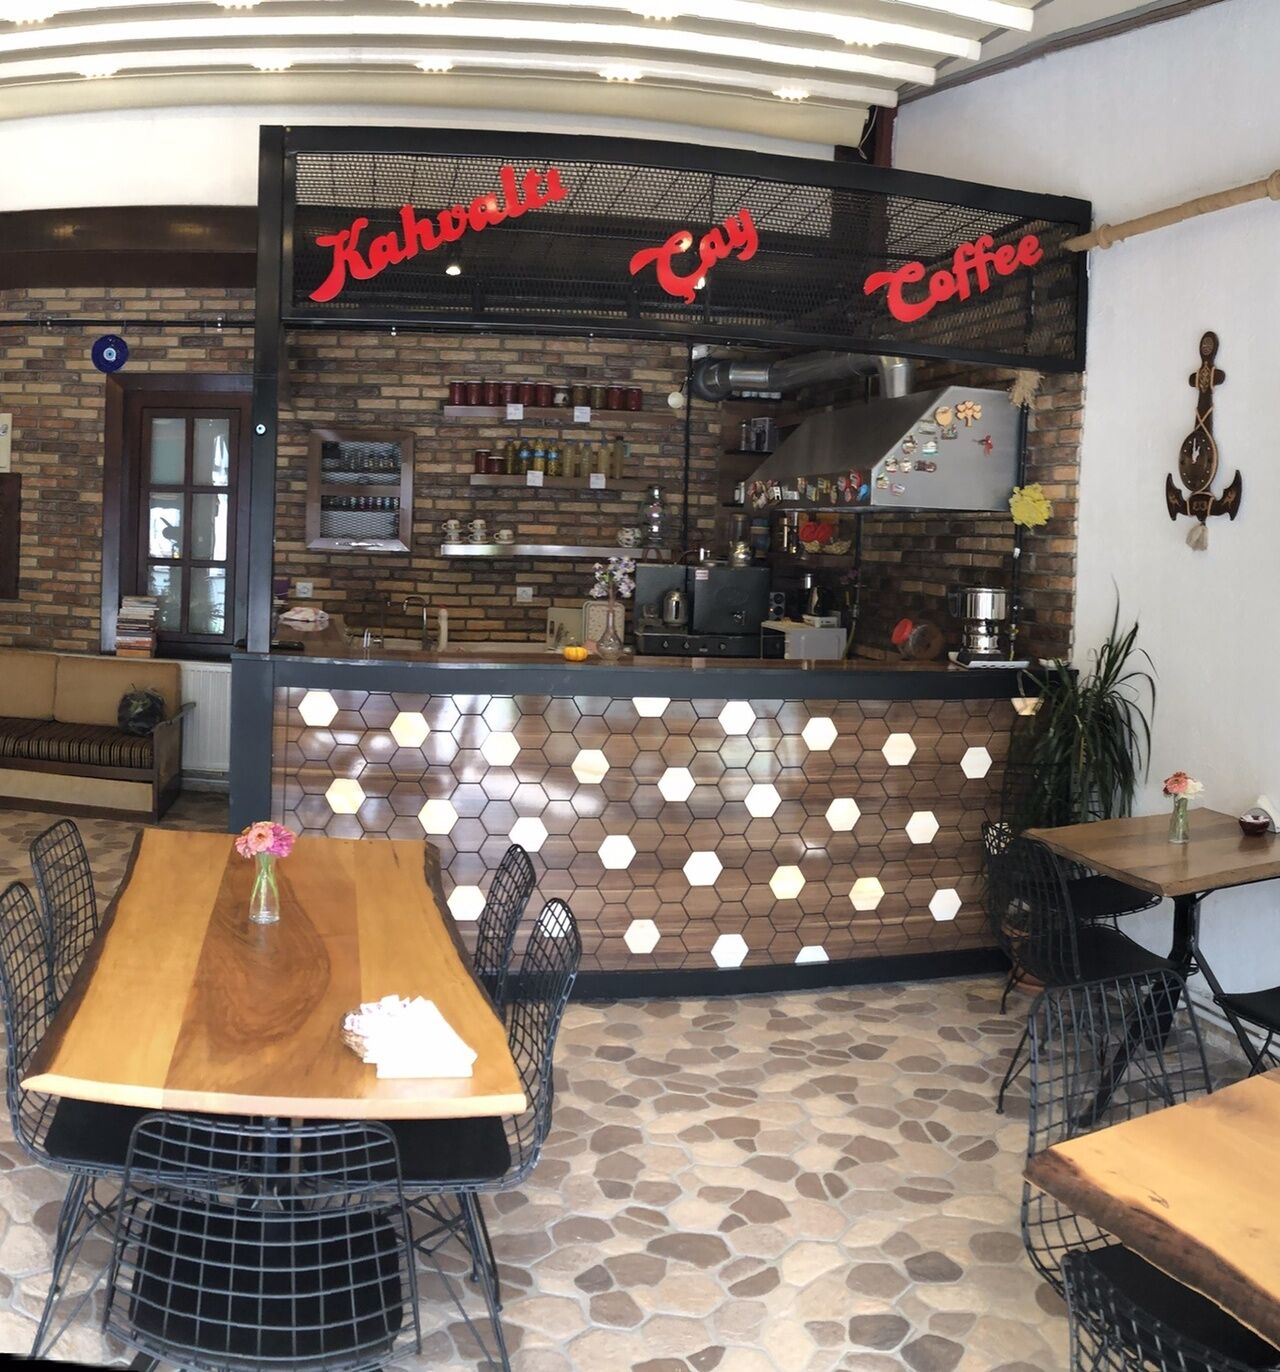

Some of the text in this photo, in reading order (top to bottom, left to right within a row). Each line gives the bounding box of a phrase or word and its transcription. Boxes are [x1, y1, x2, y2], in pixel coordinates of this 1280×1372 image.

[308, 165, 568, 302] Kahvaltı
[629, 208, 758, 304] Çay
[863, 234, 1043, 322] Coffee
